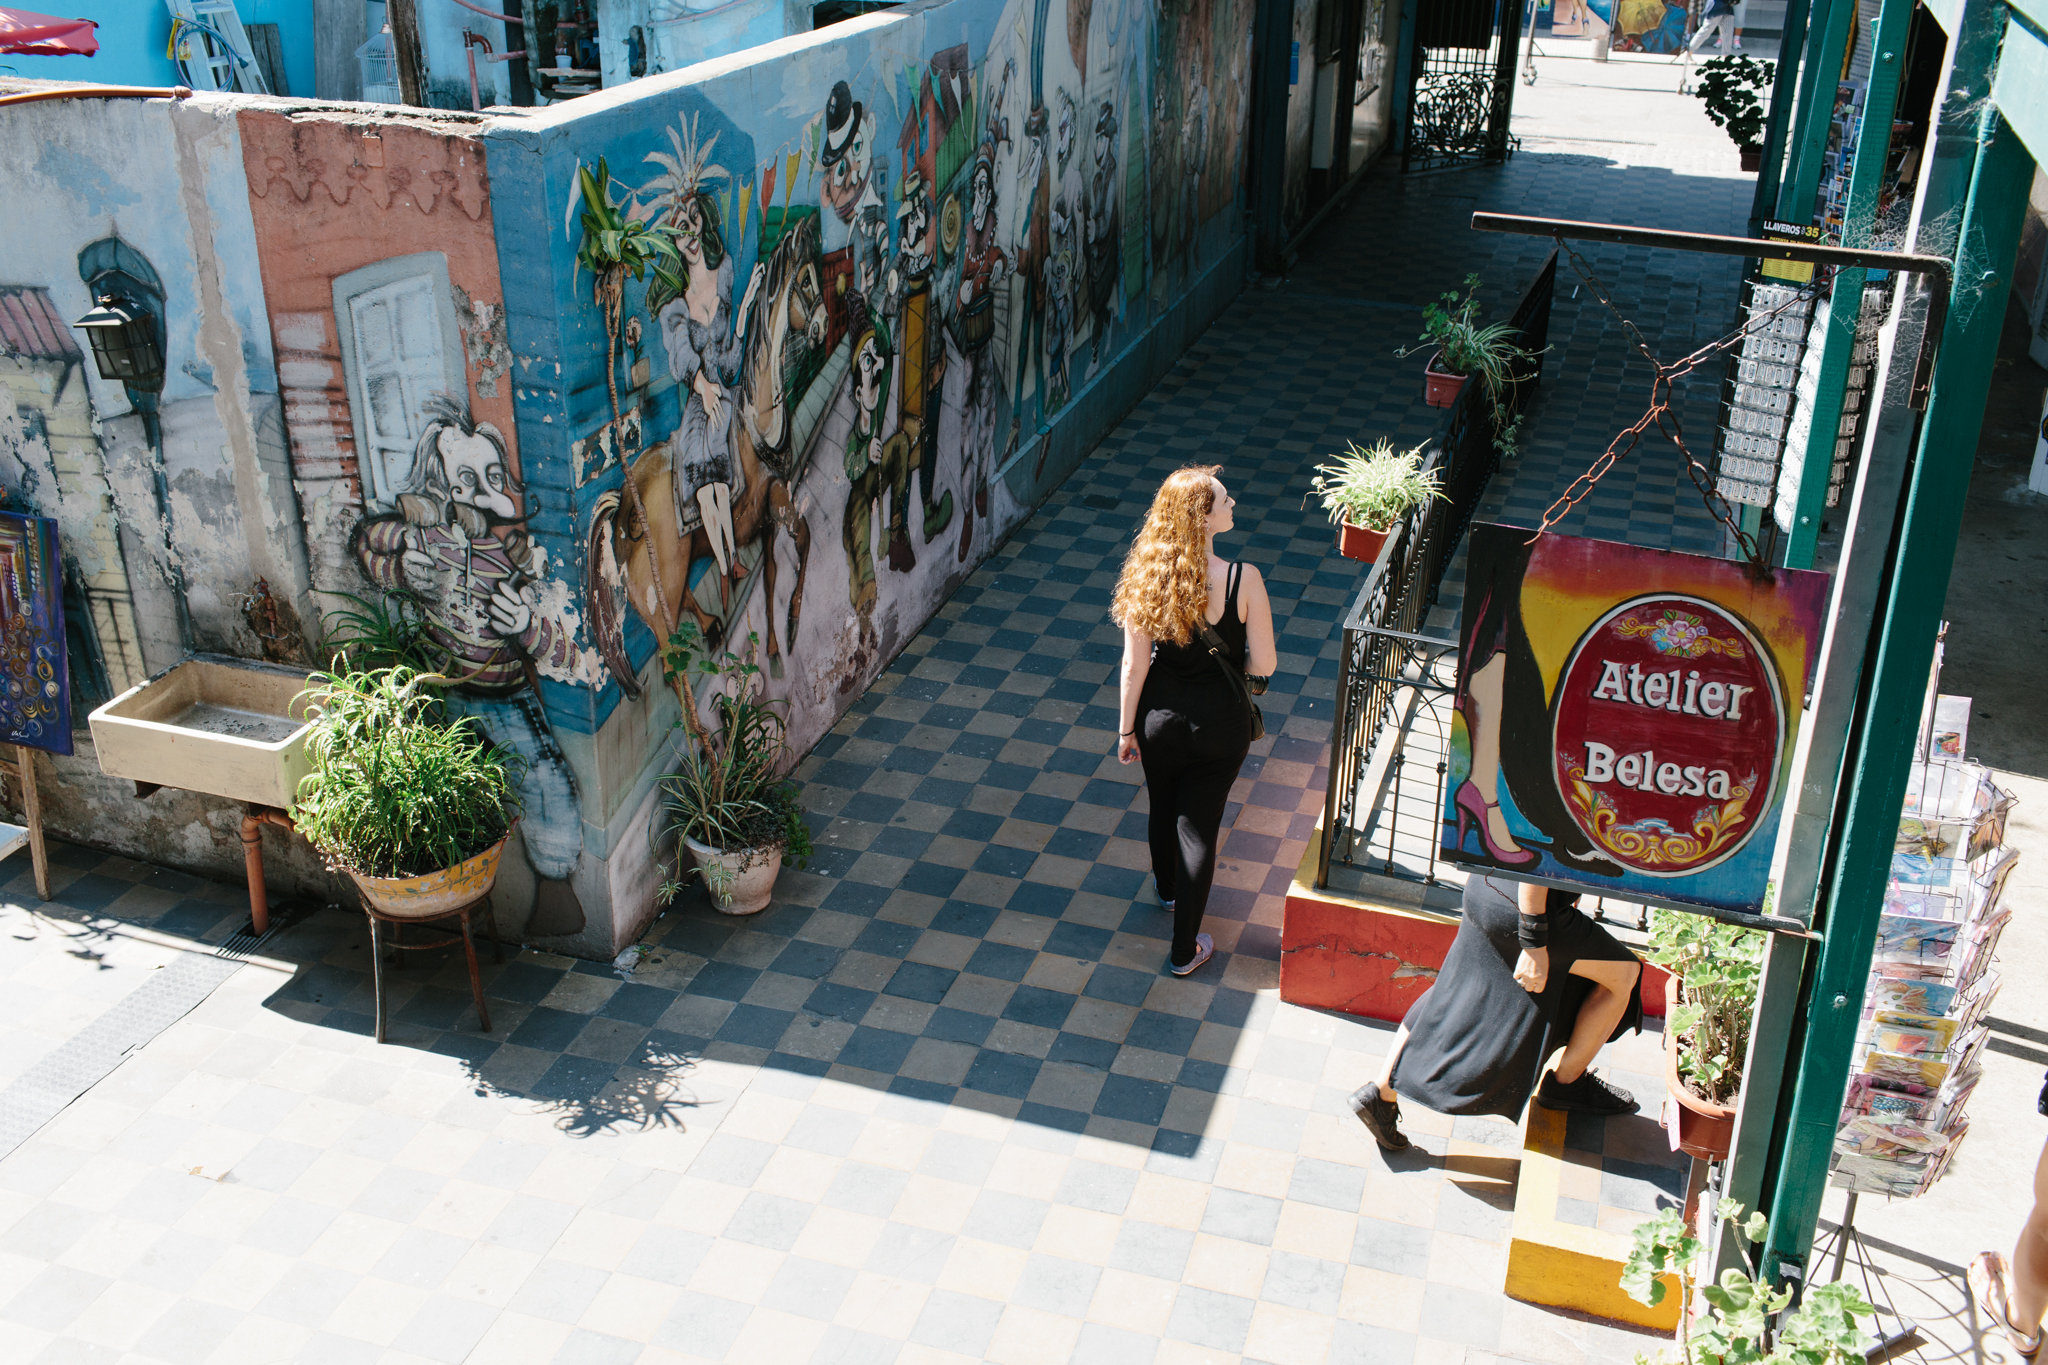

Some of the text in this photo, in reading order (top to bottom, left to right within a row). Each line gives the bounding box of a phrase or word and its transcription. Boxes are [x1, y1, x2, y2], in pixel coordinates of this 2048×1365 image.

[1763, 220, 1800, 235] LLAVEROS
[1593, 659, 1754, 721] Atelier
[1582, 741, 1731, 800] Belesa
